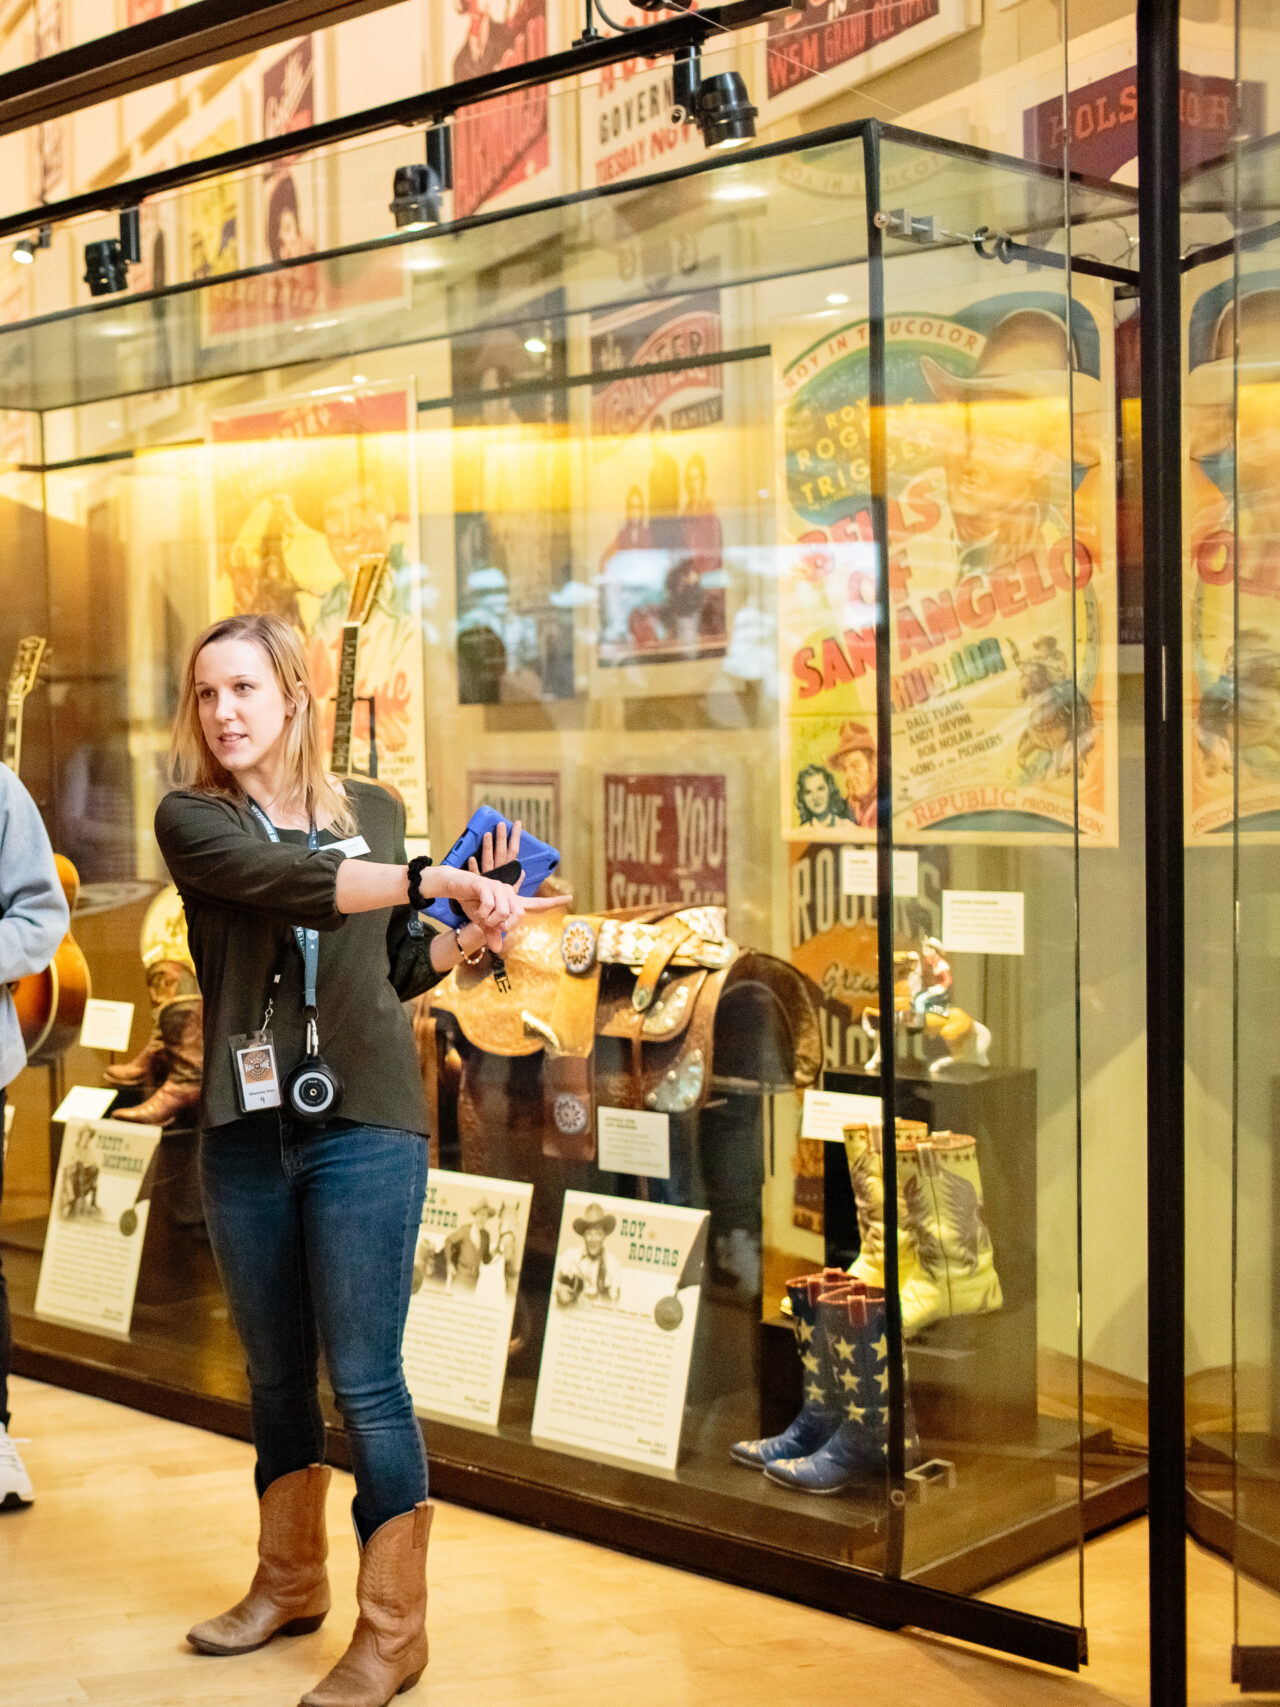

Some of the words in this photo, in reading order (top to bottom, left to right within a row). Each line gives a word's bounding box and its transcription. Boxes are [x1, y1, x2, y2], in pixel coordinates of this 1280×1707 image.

[828, 336, 848, 356] IN
[857, 319, 979, 351] TUCOLOR
[825, 396, 869, 431] ROY
[792, 626, 877, 699] SAN
[897, 537, 1094, 661] ANGELO
[905, 713, 931, 731] DALE
[932, 700, 965, 721] EVANS
[909, 727, 935, 747] ANDY
[938, 712, 973, 735] DEVINE
[938, 728, 974, 750] NOLAN
[910, 760, 937, 777] SONS
[913, 787, 1018, 827] REPUBLIC
[606, 783, 664, 867] HAVE
[673, 785, 725, 873] YOU
[422, 1207, 458, 1229] ITTER
[620, 1218, 647, 1239] ROY
[628, 1241, 680, 1268] ROGERS
